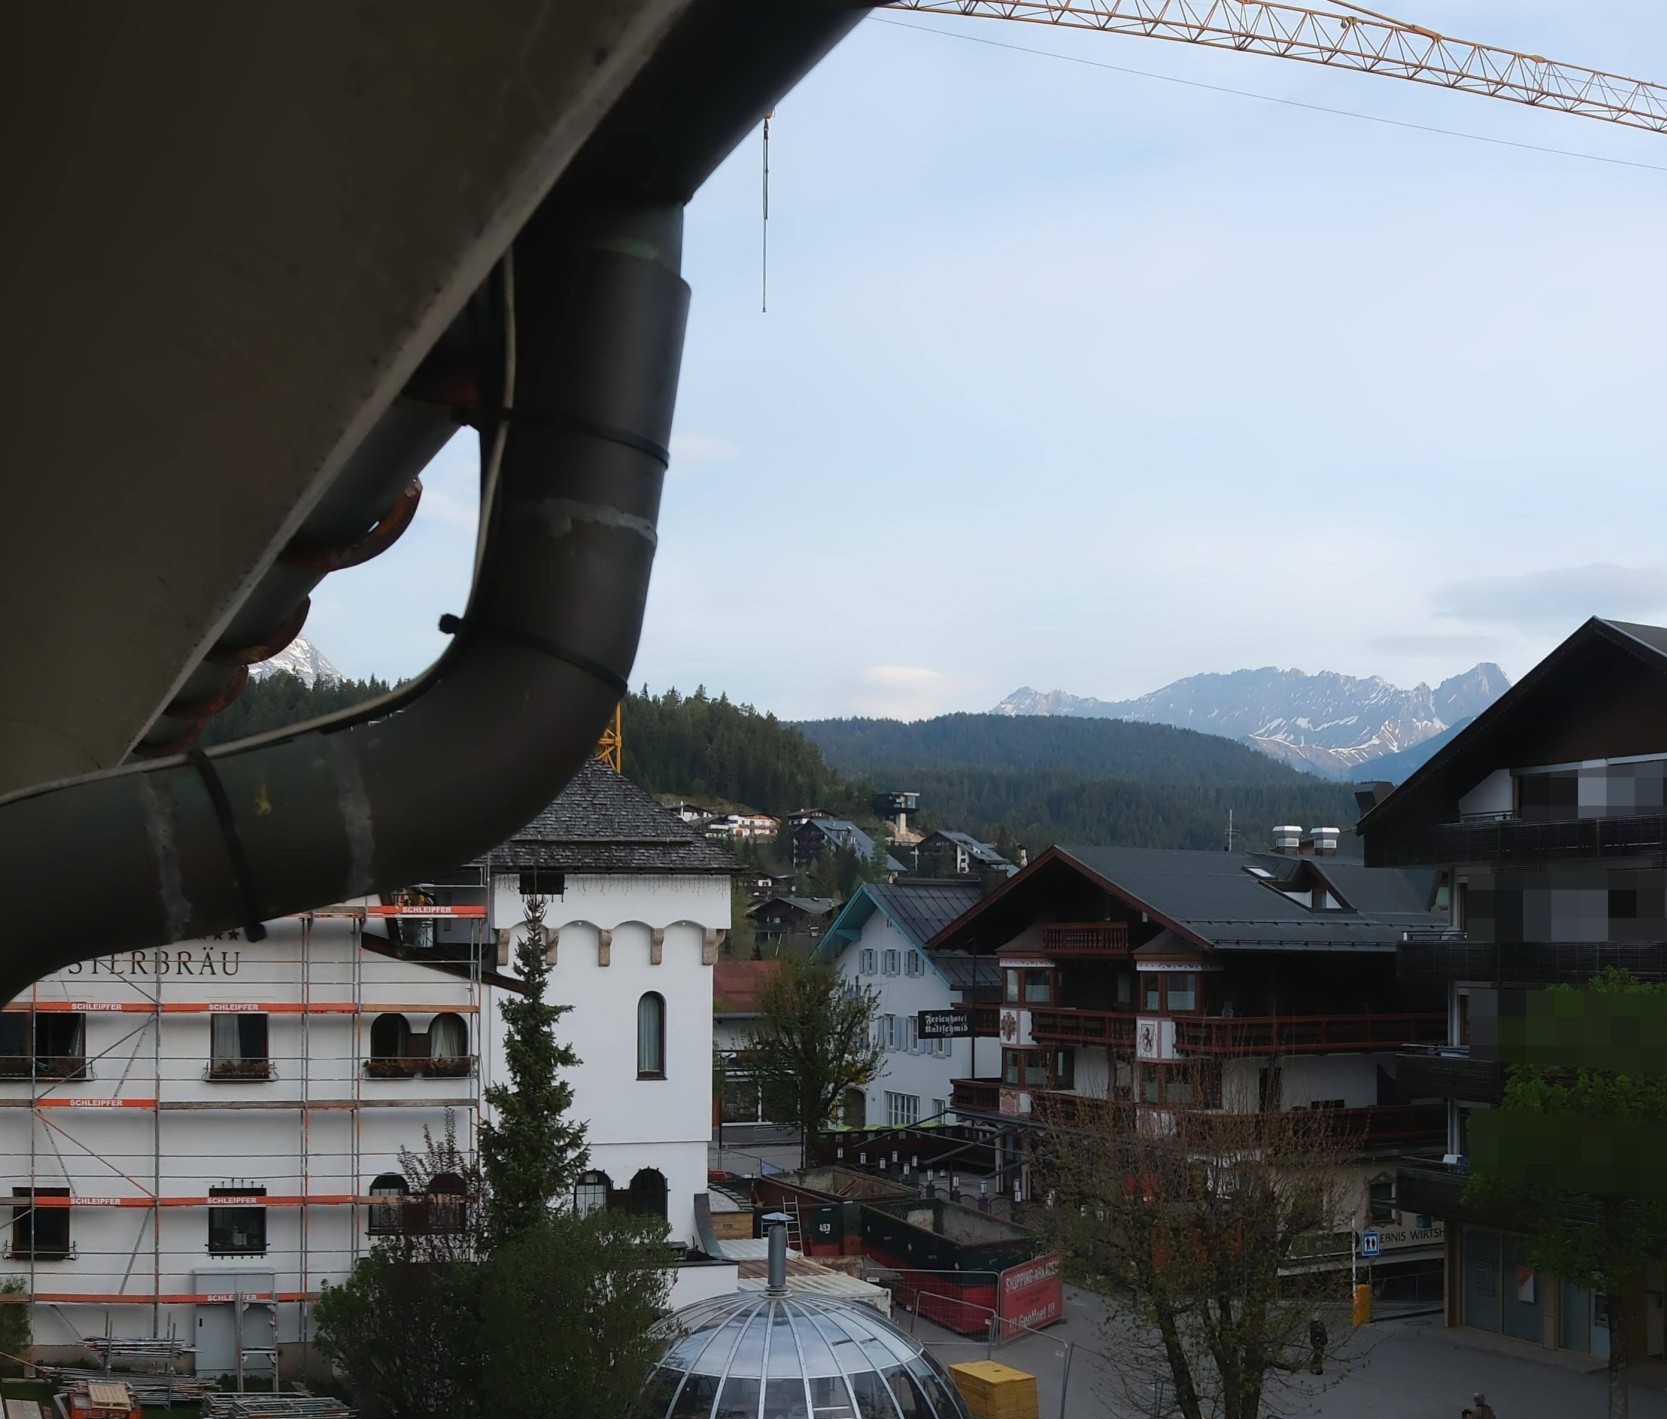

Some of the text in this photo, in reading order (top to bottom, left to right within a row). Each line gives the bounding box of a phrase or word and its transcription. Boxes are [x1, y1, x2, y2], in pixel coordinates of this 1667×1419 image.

[402, 905, 452, 914] SCHLEIPFER
[71, 1003, 122, 1011] SCHLEIPFER
[208, 1003, 259, 1011] SCHLEIPFER
[70, 1099, 123, 1107] SCHLEIPFER
[70, 1197, 121, 1205] SCHLEIPFER
